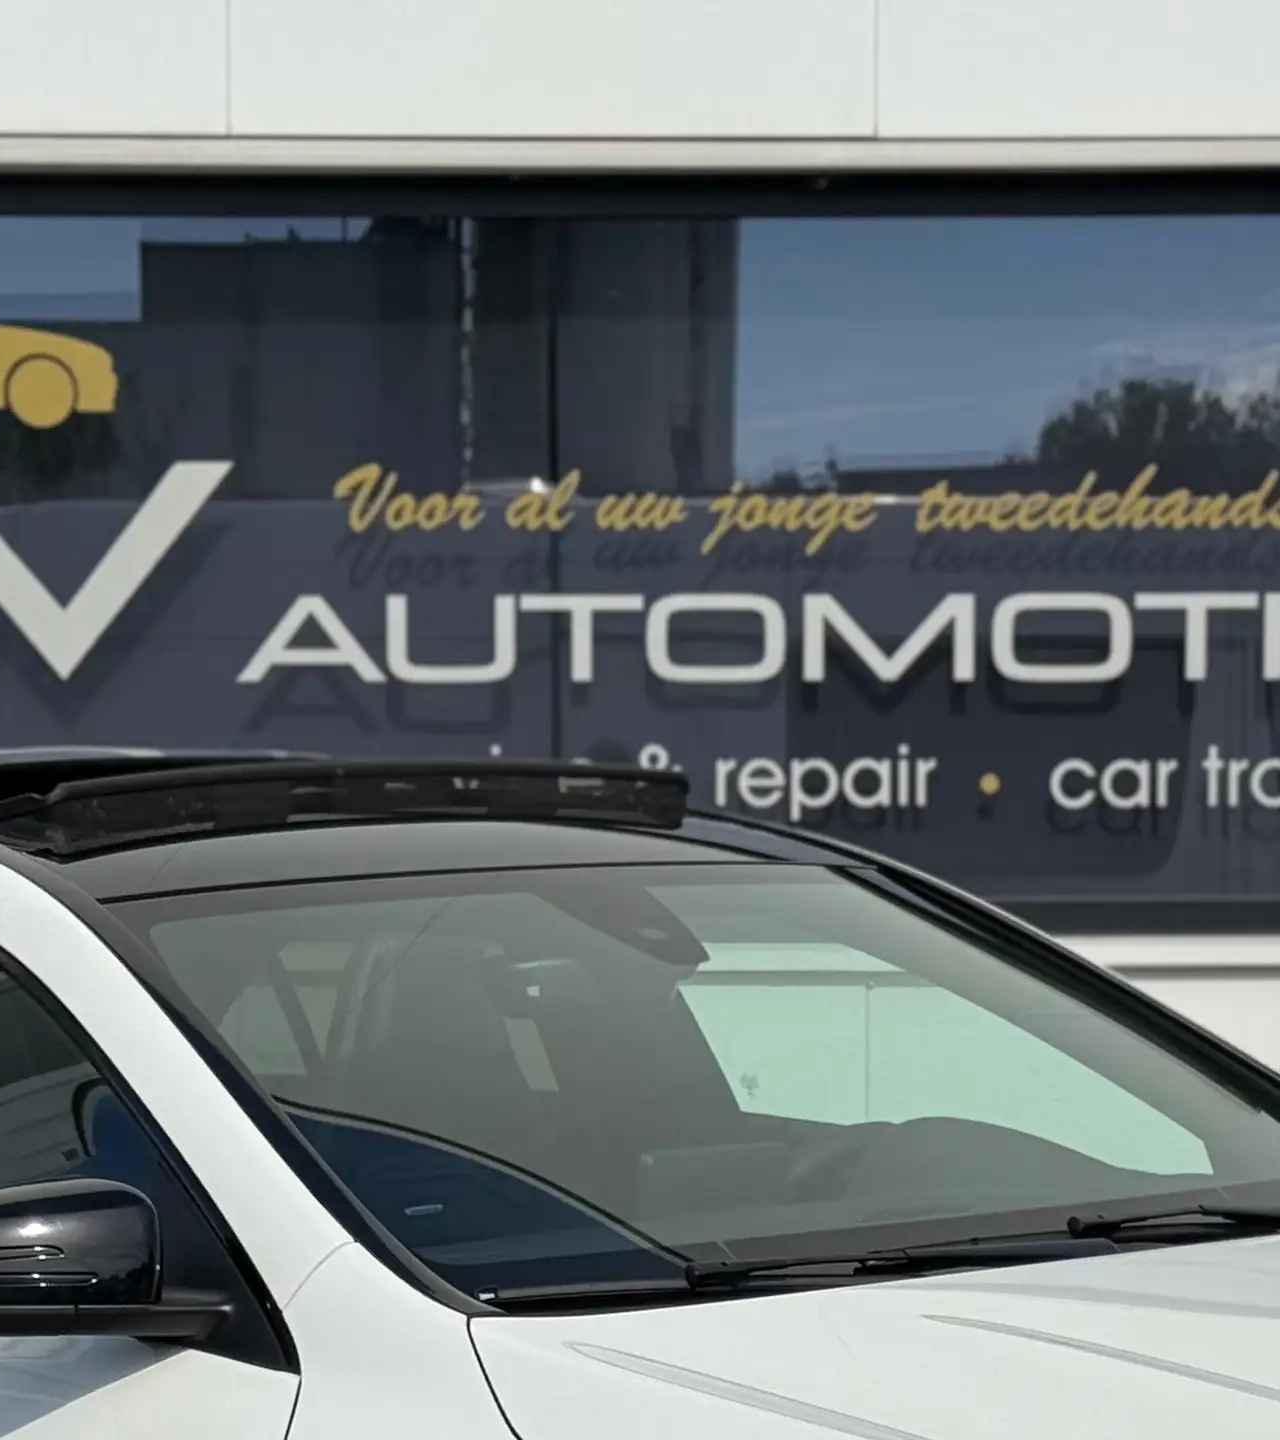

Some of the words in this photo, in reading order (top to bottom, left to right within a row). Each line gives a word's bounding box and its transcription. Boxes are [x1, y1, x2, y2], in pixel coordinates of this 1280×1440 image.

[333, 463, 486, 532] Voor
[505, 469, 581, 531] al
[596, 493, 686, 531] uw
[700, 480, 878, 556] jonge
[715, 744, 938, 822] repair
[1048, 755, 1178, 810] car
